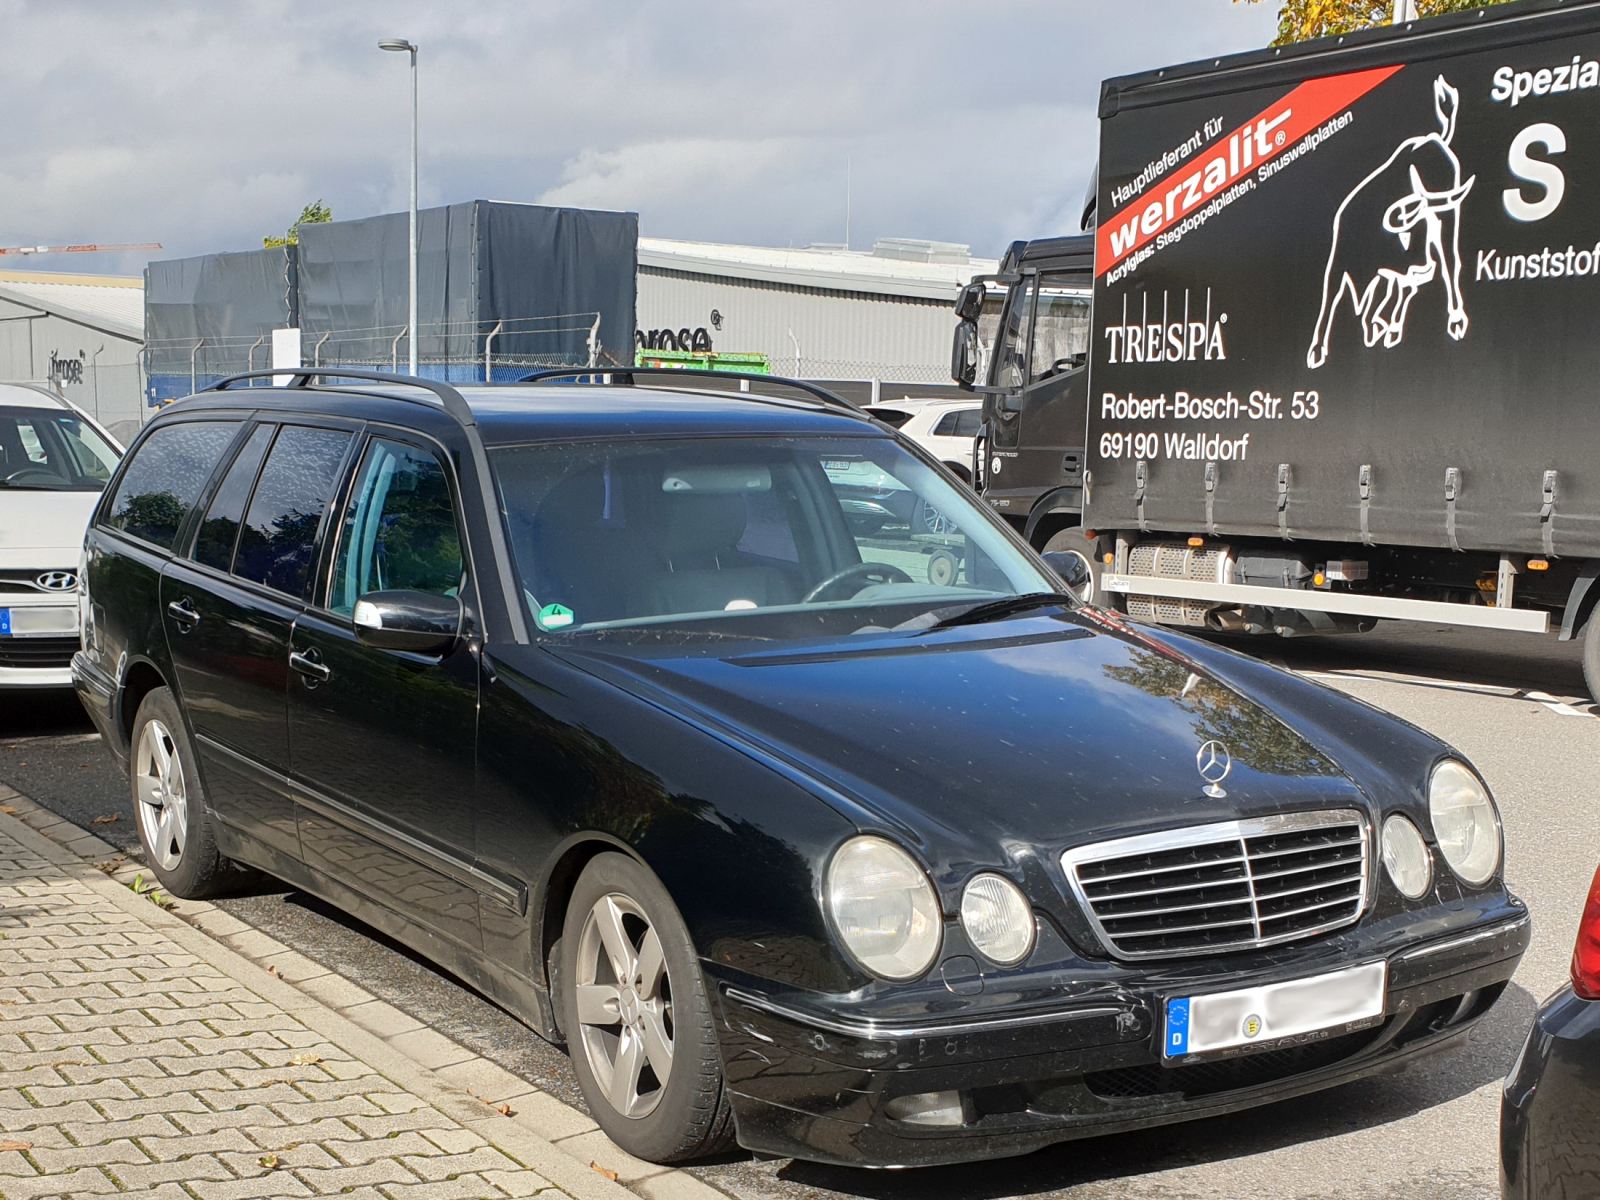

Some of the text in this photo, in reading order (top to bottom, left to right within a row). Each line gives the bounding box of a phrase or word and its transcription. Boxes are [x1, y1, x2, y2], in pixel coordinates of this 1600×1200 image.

[1491, 55, 1600, 107] Spezia
[1110, 115, 1224, 208] Hauptlieferant für
[1502, 122, 1567, 222] S
[1106, 110, 1354, 287] Acrylglas: Stegdoppelplatten, Sinuswellplatten
[1101, 390, 1320, 420] Robert-Bosch-Str. 53
[1099, 432, 1250, 461] 69190 Walldorf
[551, 604, 562, 616] 4
[1172, 1032, 1183, 1046] D
